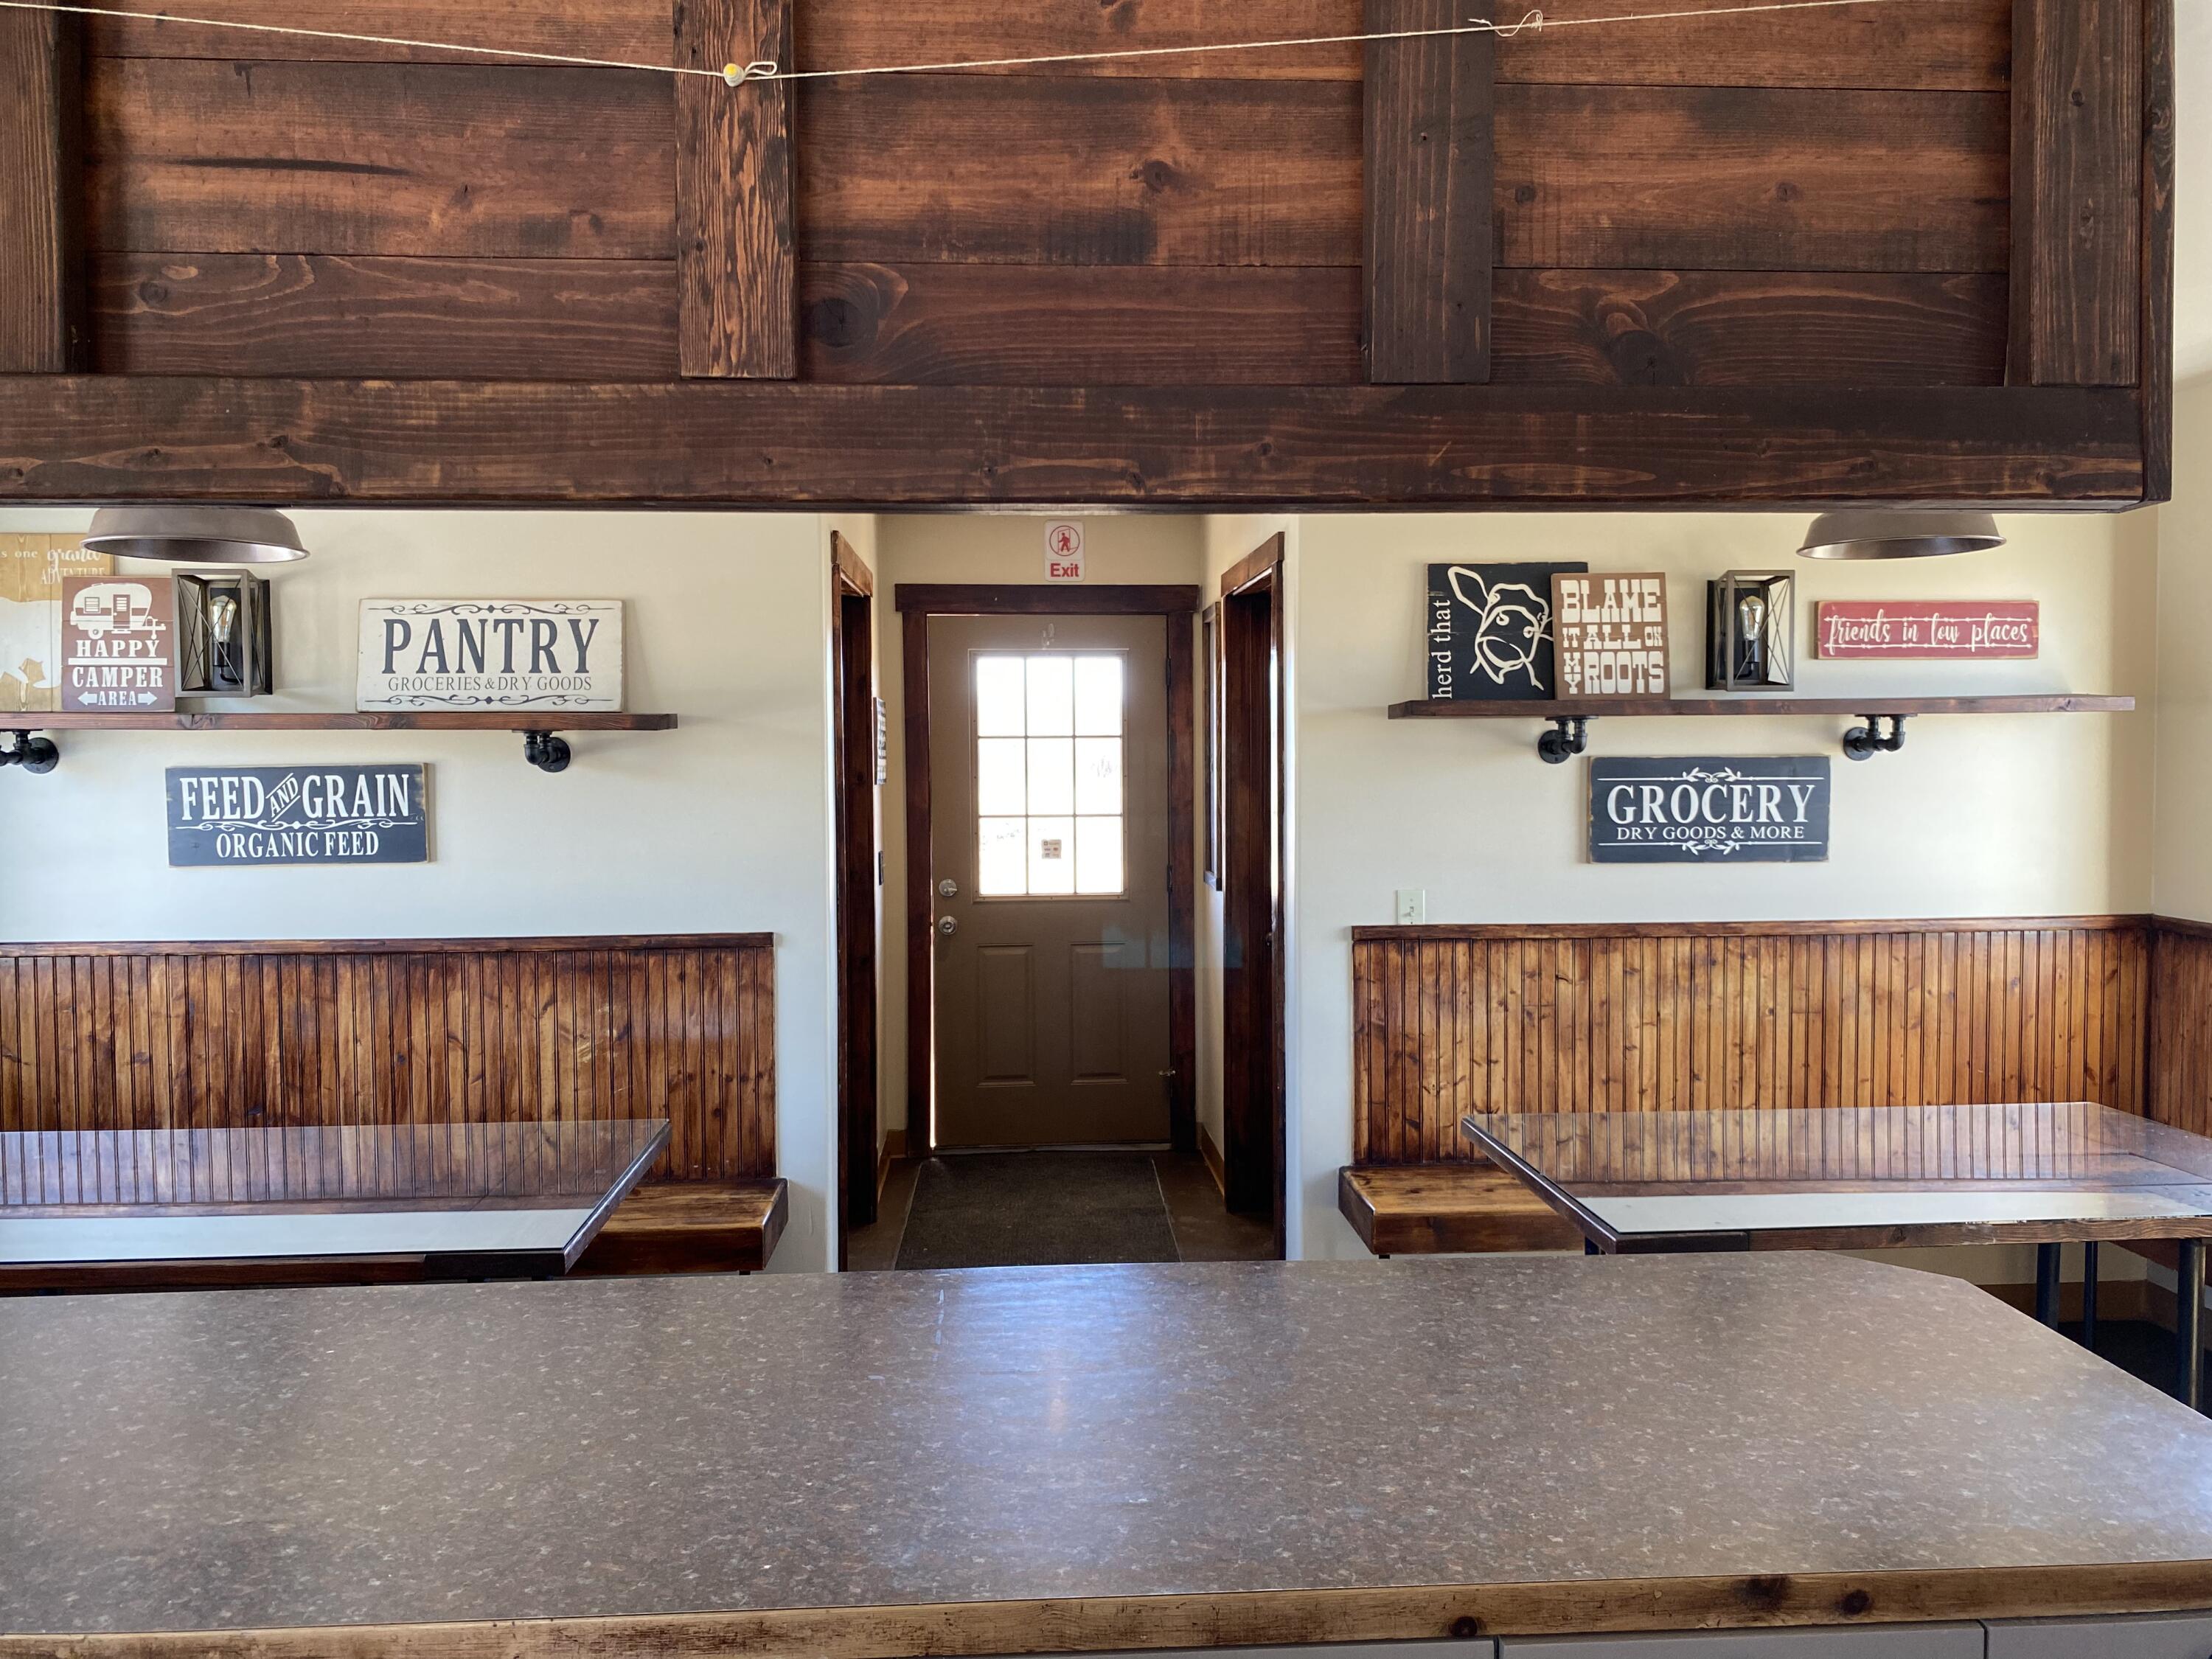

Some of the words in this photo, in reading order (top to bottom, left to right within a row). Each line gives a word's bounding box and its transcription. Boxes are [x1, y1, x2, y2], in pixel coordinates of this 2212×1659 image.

[15, 550, 38, 558] one
[1050, 563, 1079, 577] Exit
[1560, 579, 1662, 623] BLAME
[1430, 599, 1451, 641] that
[1829, 609, 1891, 655] friends
[1902, 622, 1918, 641] in
[1930, 612, 1961, 646] low
[1971, 612, 2028, 652] places
[76, 639, 160, 658] HAPPY
[381, 619, 599, 674] PANTRY
[1562, 627, 1580, 648] IT
[1584, 624, 1642, 650] ALL
[72, 666, 164, 688] CAMPER
[388, 676, 481, 692] GROCERIES
[484, 678, 496, 690] &
[497, 676, 532, 691] DRY
[537, 676, 592, 692] GOODS
[1432, 650, 1453, 699] herd
[1563, 652, 1582, 695] MY
[1585, 650, 1664, 695] ROOTS
[98, 690, 137, 706] AREA
[179, 776, 265, 821] FEED
[270, 776, 299, 818] AND
[302, 773, 409, 819] GRAIN
[1607, 784, 1816, 824] GROCERY
[216, 832, 319, 859] ORGANIC
[324, 830, 379, 856] FEED
[1616, 827, 1658, 840] DRY
[1663, 826, 1726, 840] GOODS
[1731, 827, 1745, 839] &
[1750, 826, 1805, 839] MORE
